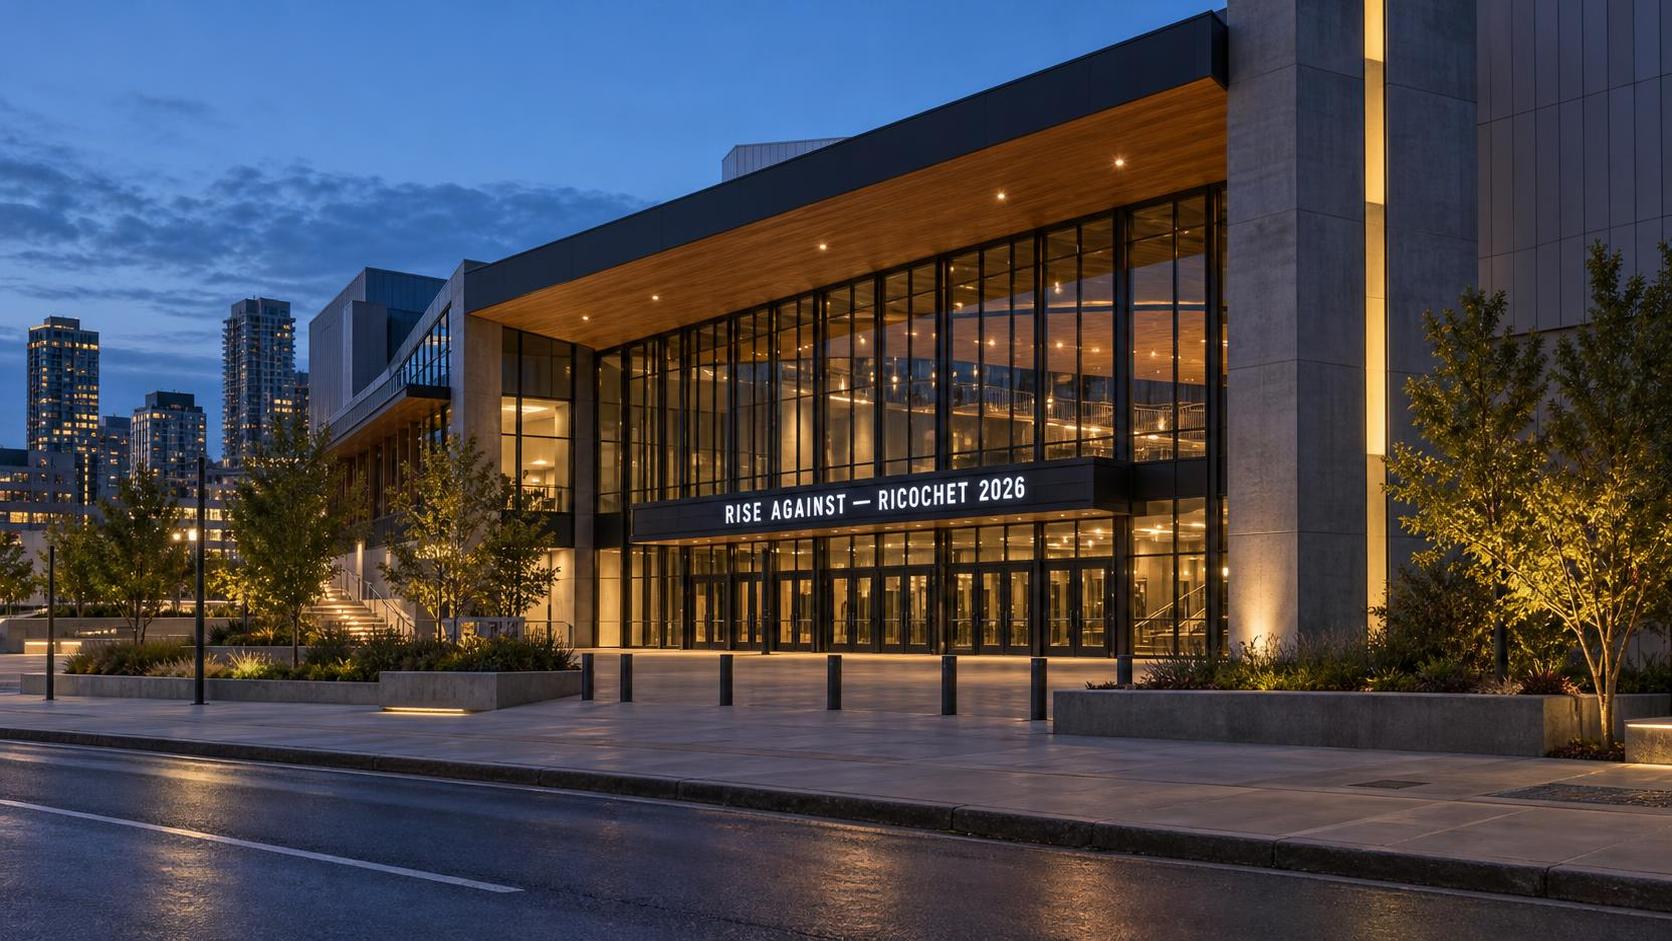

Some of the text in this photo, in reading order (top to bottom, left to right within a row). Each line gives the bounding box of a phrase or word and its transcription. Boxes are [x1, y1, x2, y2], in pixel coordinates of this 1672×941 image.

[724, 502, 762, 526] RISE
[770, 493, 847, 522] AGAINST
[877, 481, 969, 512] RICOCHET
[978, 475, 1027, 502] 2026
